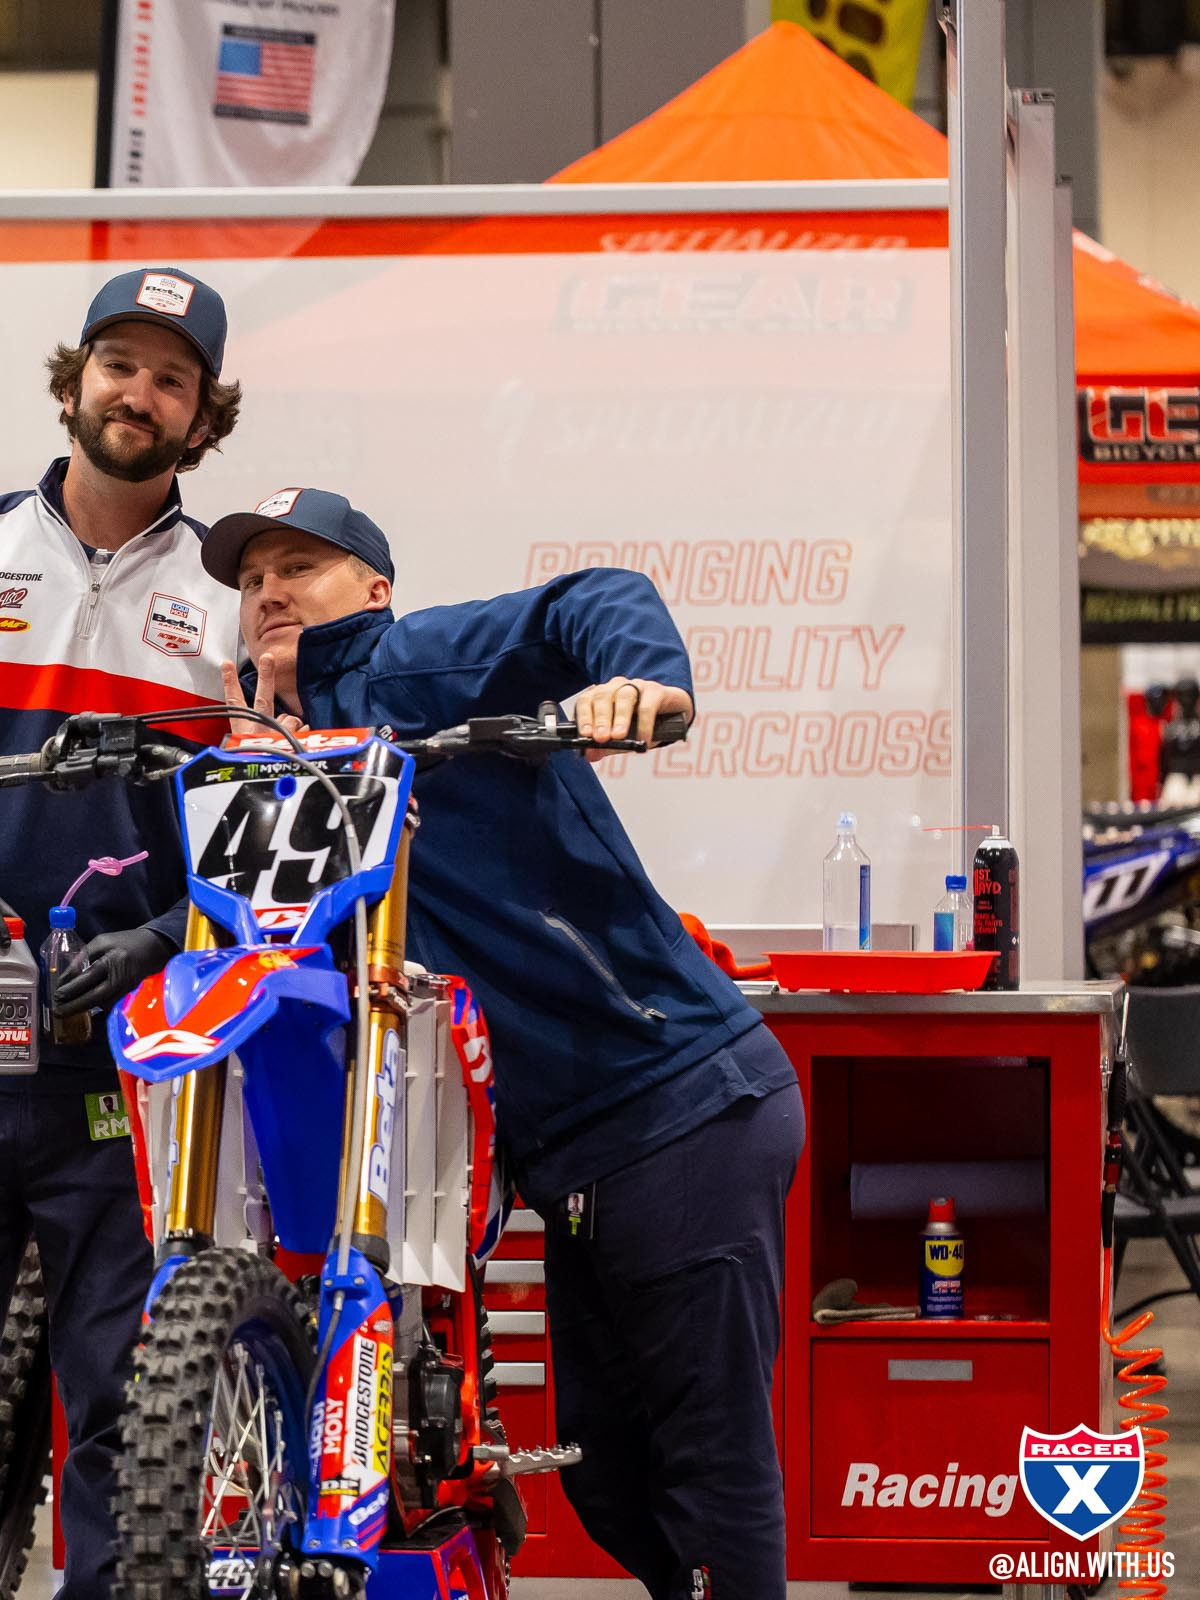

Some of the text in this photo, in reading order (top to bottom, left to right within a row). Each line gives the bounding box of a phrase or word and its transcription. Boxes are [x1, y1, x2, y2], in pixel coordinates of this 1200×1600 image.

[152, 613, 198, 632] Beta
[170, 609, 188, 618] MOLY
[688, 625, 905, 692] BILITY
[260, 760, 328, 774] MONSER
[602, 711, 951, 778] ERCROSS
[198, 775, 387, 904] 49
[94, 1118, 129, 1137] RM
[324, 1397, 344, 1455] MOLY
[352, 1339, 375, 1468] BRIDGESTONE
[348, 1488, 390, 1525] Bet
[841, 1462, 1019, 1517] Racing
